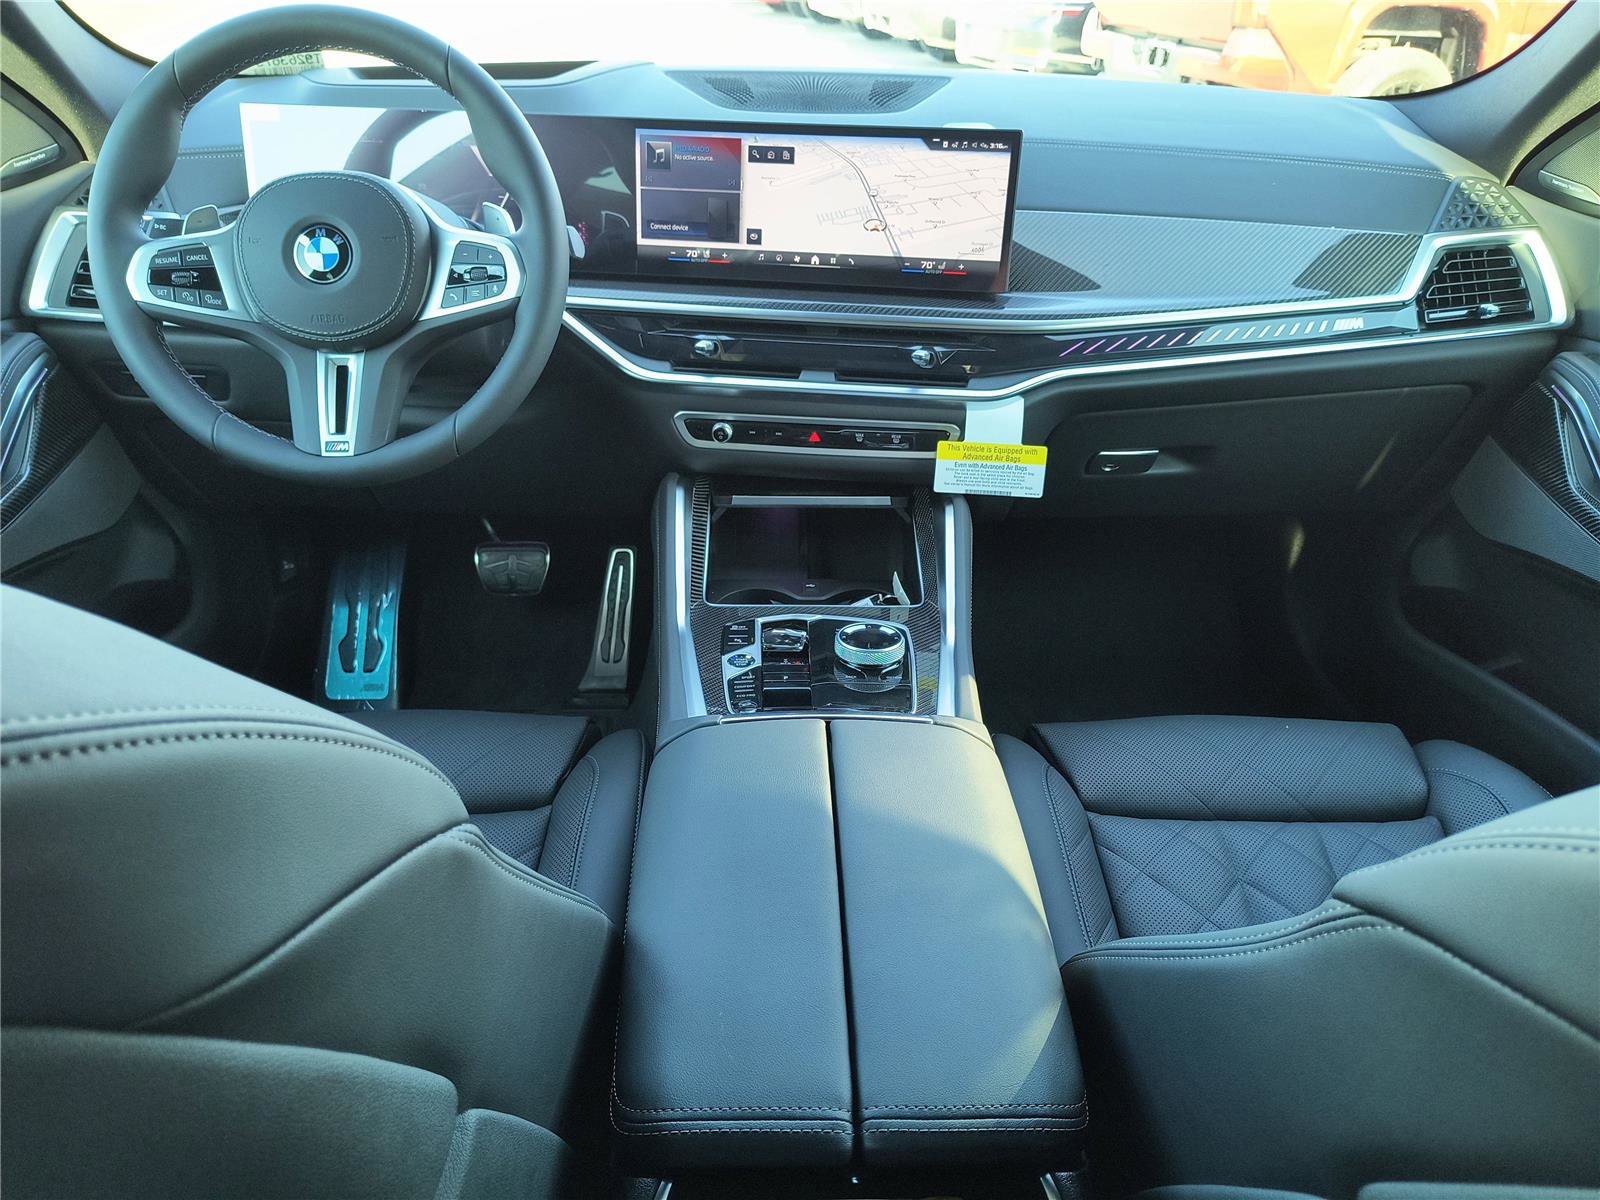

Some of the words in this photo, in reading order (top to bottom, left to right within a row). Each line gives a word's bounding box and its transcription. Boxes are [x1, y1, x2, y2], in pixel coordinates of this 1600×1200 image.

[650, 222, 672, 231] Connect
[671, 224, 689, 232] device
[310, 313, 346, 325] AIRBAG
[993, 447, 1023, 455] Equipped
[962, 453, 993, 461] Advanced
